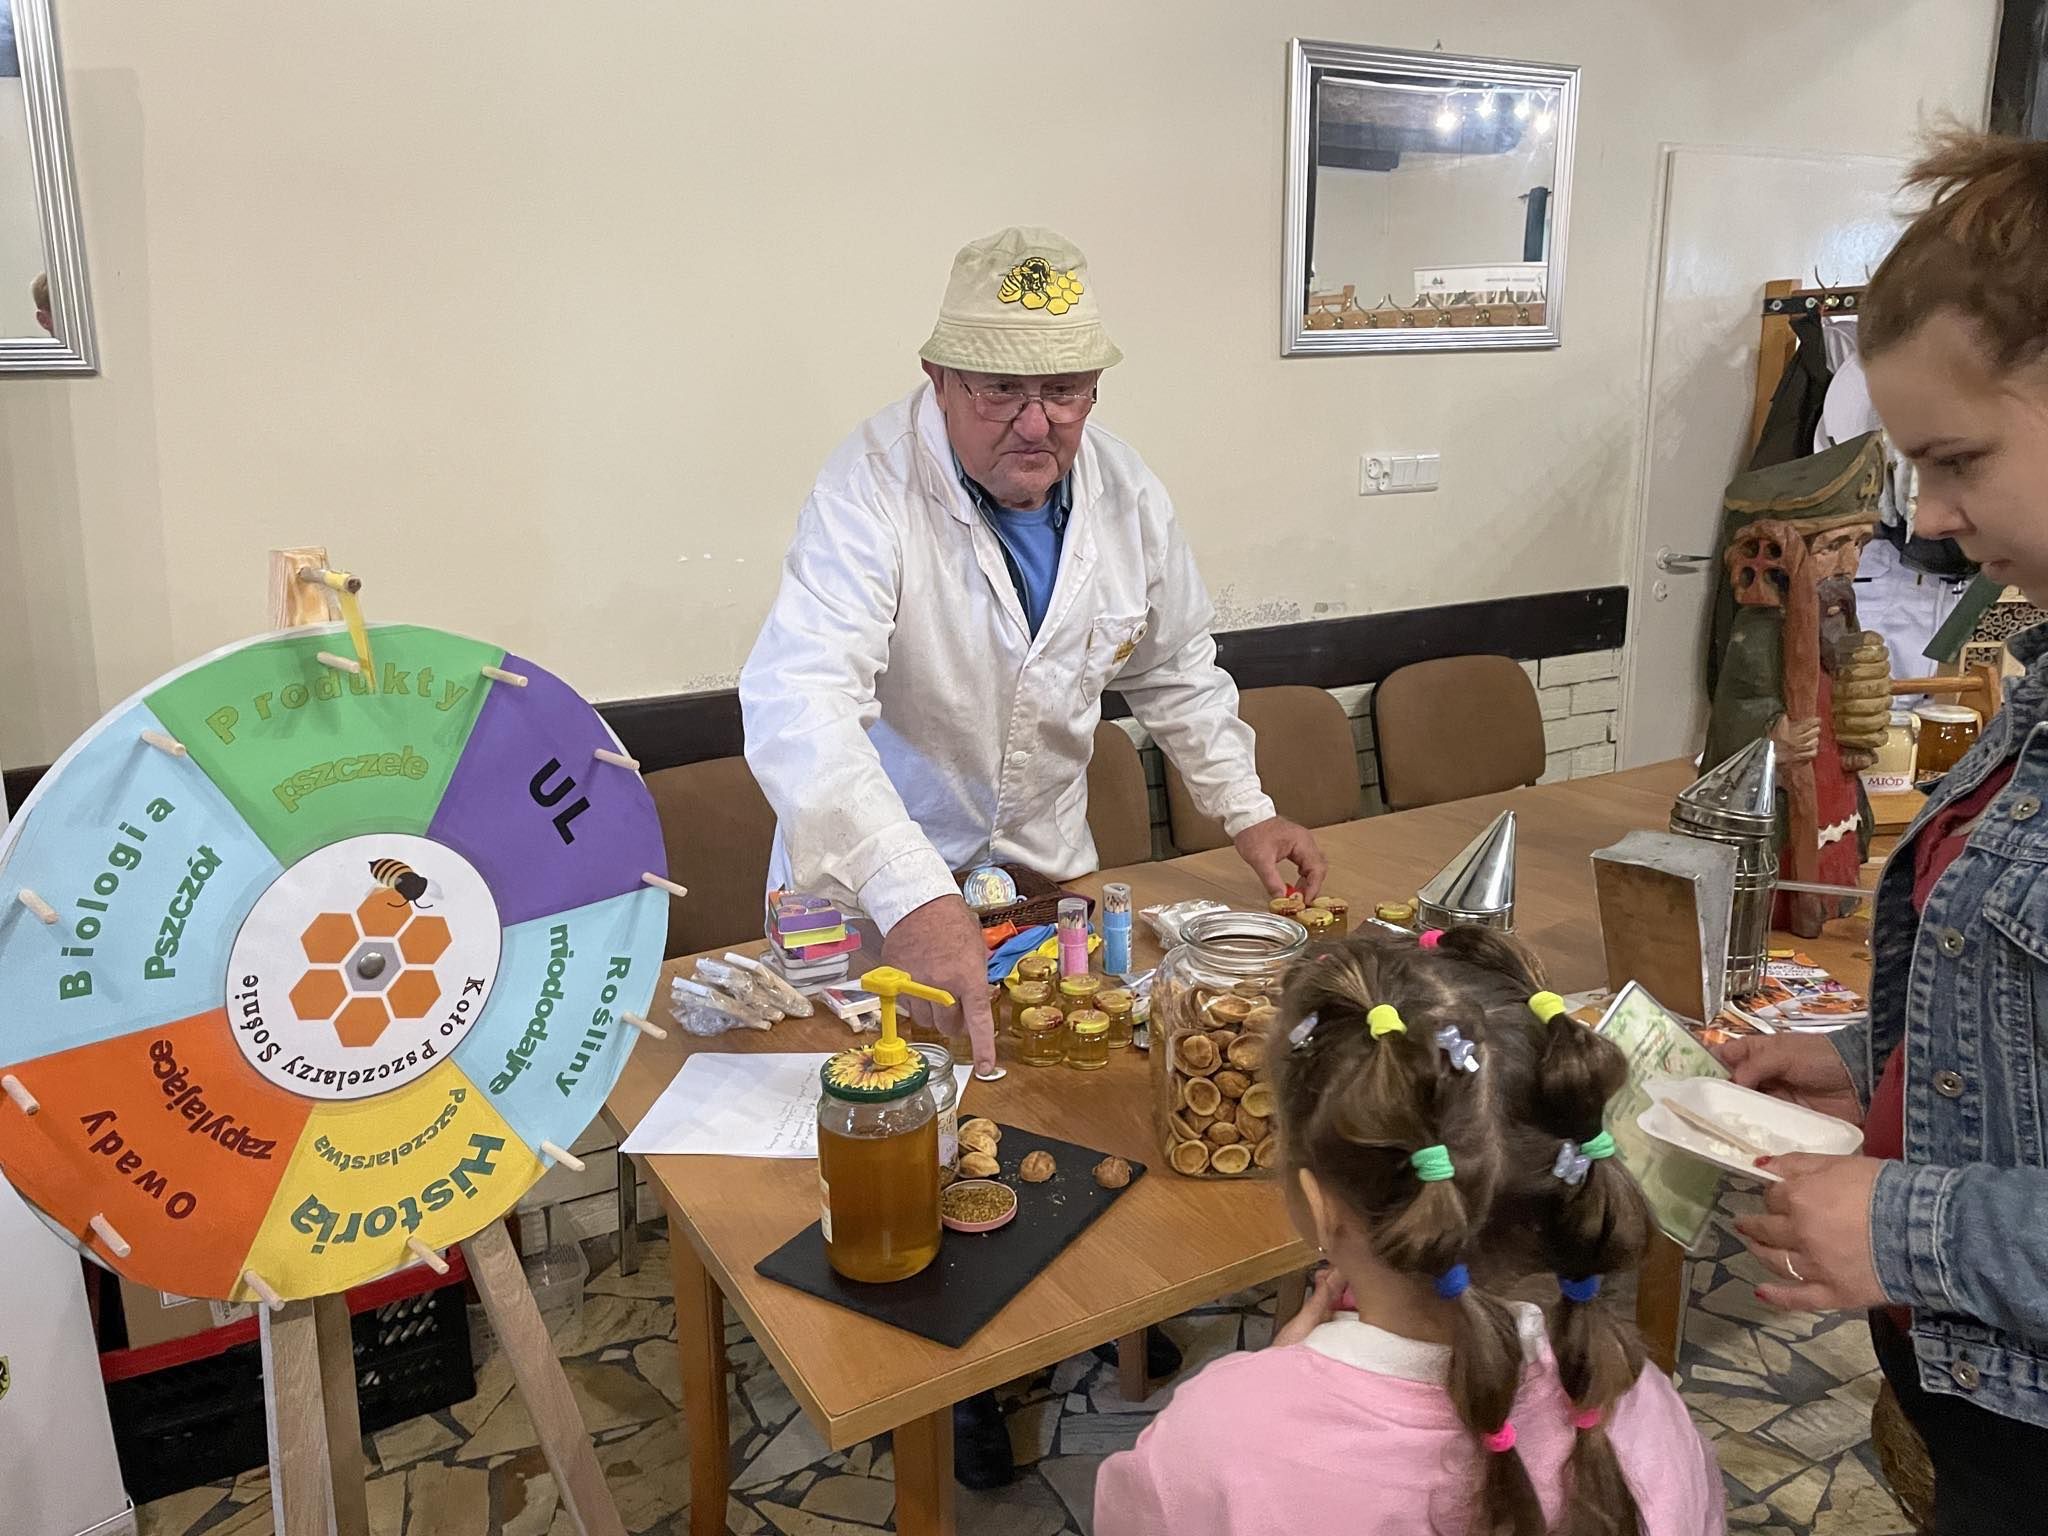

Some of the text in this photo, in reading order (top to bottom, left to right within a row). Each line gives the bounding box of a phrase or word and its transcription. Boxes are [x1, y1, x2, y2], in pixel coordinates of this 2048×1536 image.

[205, 663, 468, 745] Produkty
[272, 745, 429, 814] pszczele
[529, 757, 591, 846] UL
[59, 797, 176, 1000] Biologia
[144, 844, 223, 980] Pszczół
[234, 974, 485, 1092] Koło Pszczelarzy Sośnie
[488, 923, 574, 1096] miododajne
[555, 956, 631, 1097] Rośliny
[149, 1039, 277, 1160] zapylające
[80, 1110, 197, 1219] Owady
[290, 1132, 506, 1255] Historia
